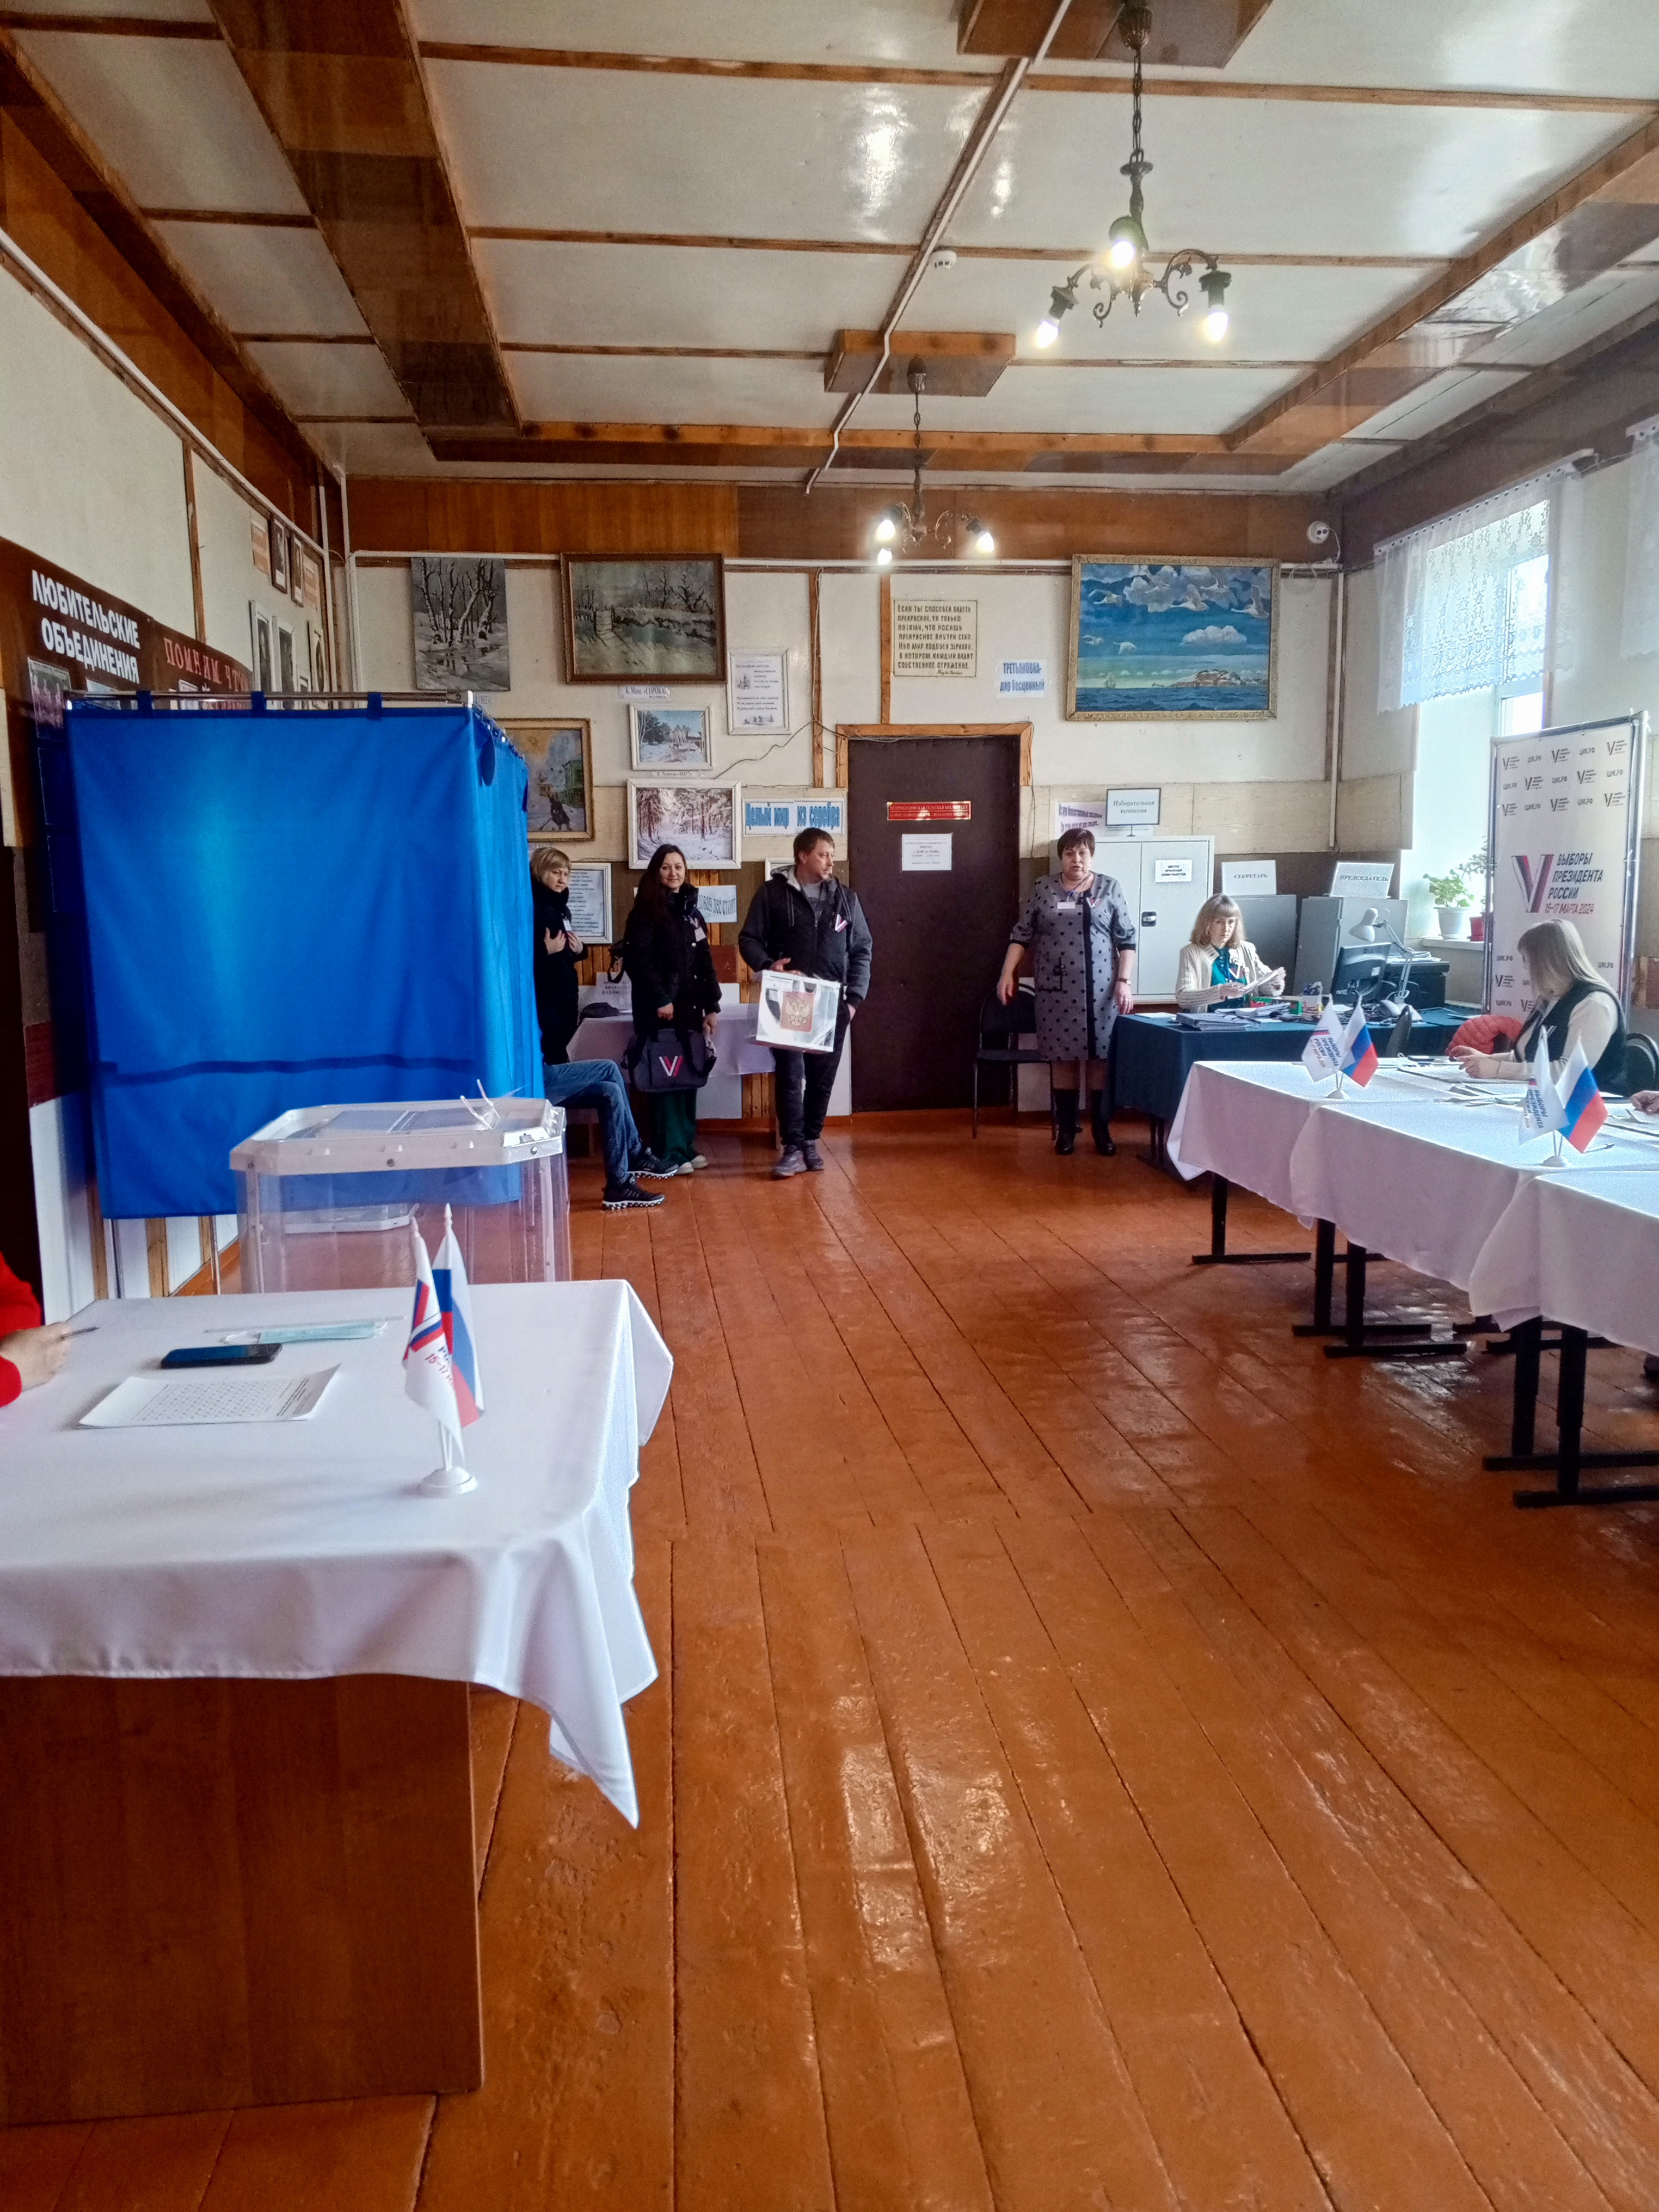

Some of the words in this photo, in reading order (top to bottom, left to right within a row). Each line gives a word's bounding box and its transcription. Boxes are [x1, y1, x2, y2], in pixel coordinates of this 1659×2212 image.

[32, 569, 140, 649] ЛЮБИТЕЛЬСКИЕ
[41, 617, 140, 684] ОБЪЕДИНЕНИЯ
[797, 806, 807, 826] из
[1557, 852, 1593, 866] ВЫБОРЫ
[1552, 870, 1603, 884] ПРЕЗИДЕНТА
[1547, 887, 1580, 899] РОССИИ
[1559, 904, 1578, 914] МАРТА
[1578, 904, 1594, 914] 2024
[1314, 1039, 1328, 1056] РОССИИ
[1320, 1038, 1340, 1066] ПРЕЗИДЕНТА
[1328, 1037, 1342, 1058] ВЫБОРЫ
[1529, 1089, 1544, 1128] ПРЕЗИДЕНТА
[1534, 1090, 1548, 1117] ВЫБОРЫ
